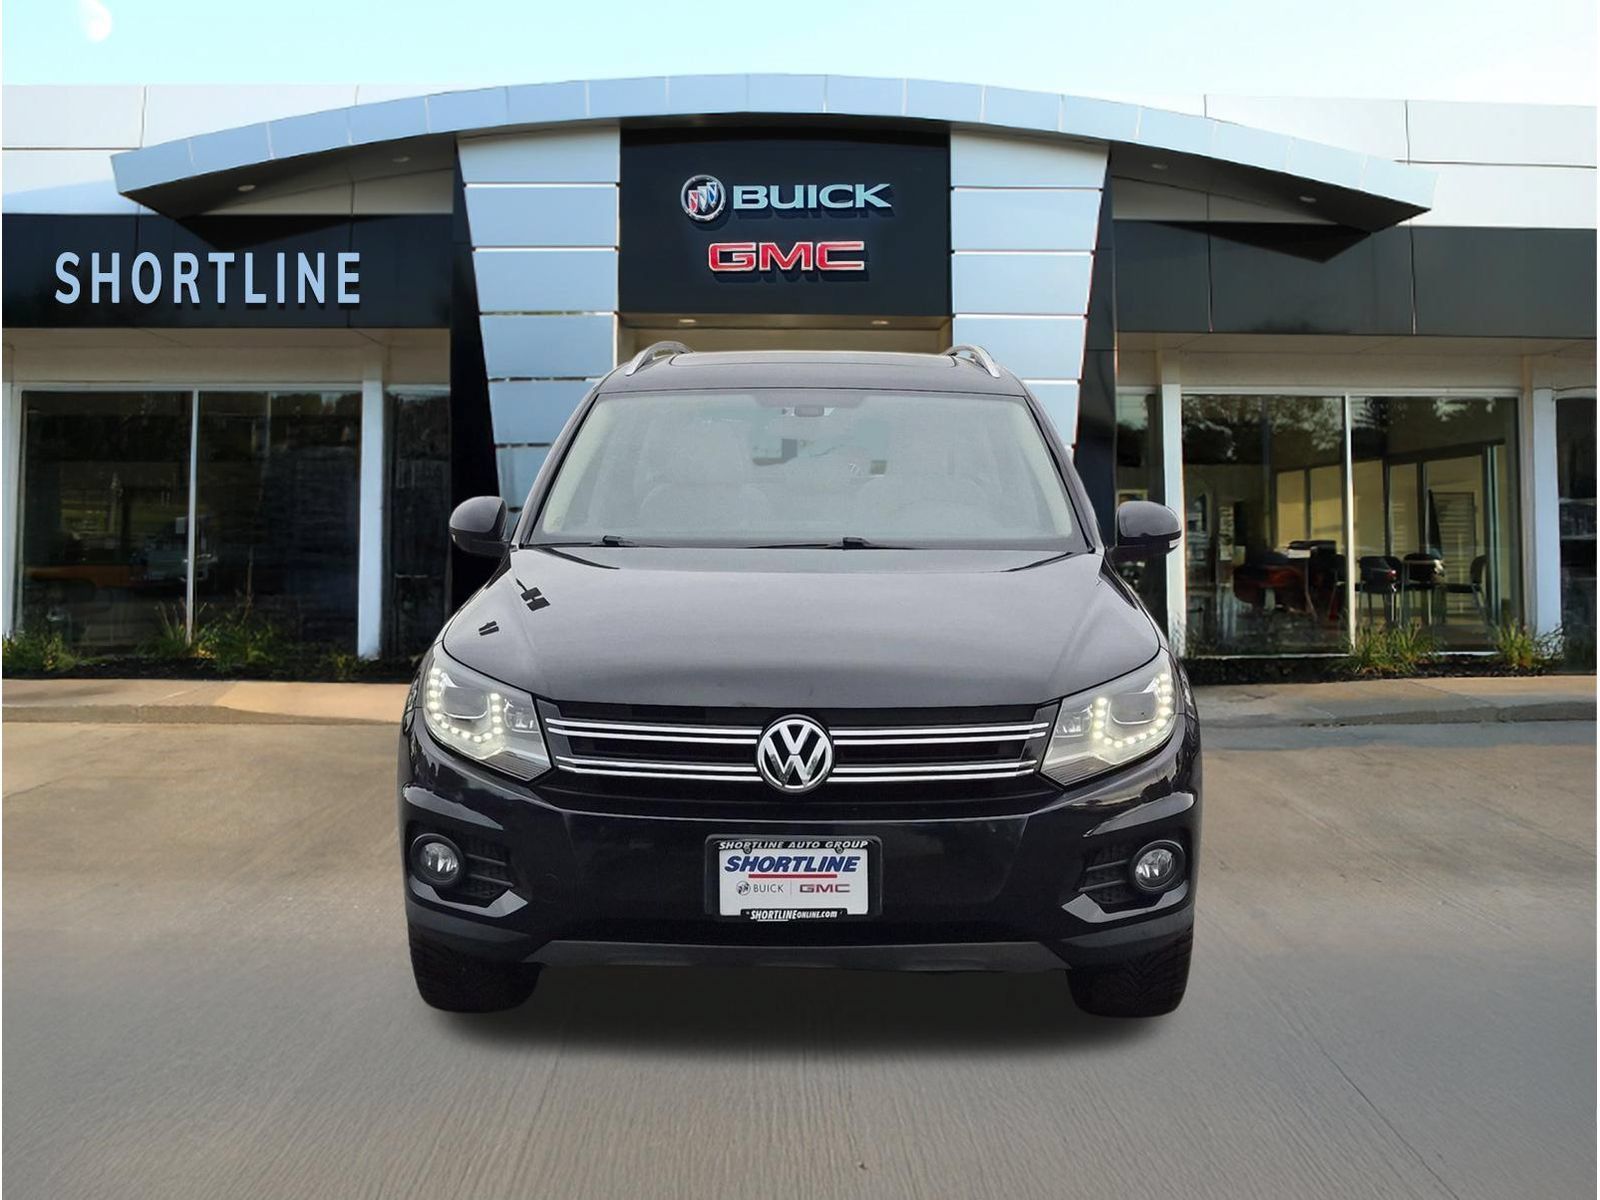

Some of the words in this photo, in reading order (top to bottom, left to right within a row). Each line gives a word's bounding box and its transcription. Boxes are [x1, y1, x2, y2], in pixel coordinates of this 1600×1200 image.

[732, 183, 893, 210] BUICK
[708, 241, 865, 271] GMC
[54, 251, 361, 305] SHORTLINE
[718, 840, 785, 850] SHORTLINE
[788, 840, 820, 849] AUTO
[824, 840, 869, 849] GROUP
[724, 855, 861, 873] SHORTLINE
[753, 882, 784, 893] BUICK
[799, 883, 850, 893] GMC
